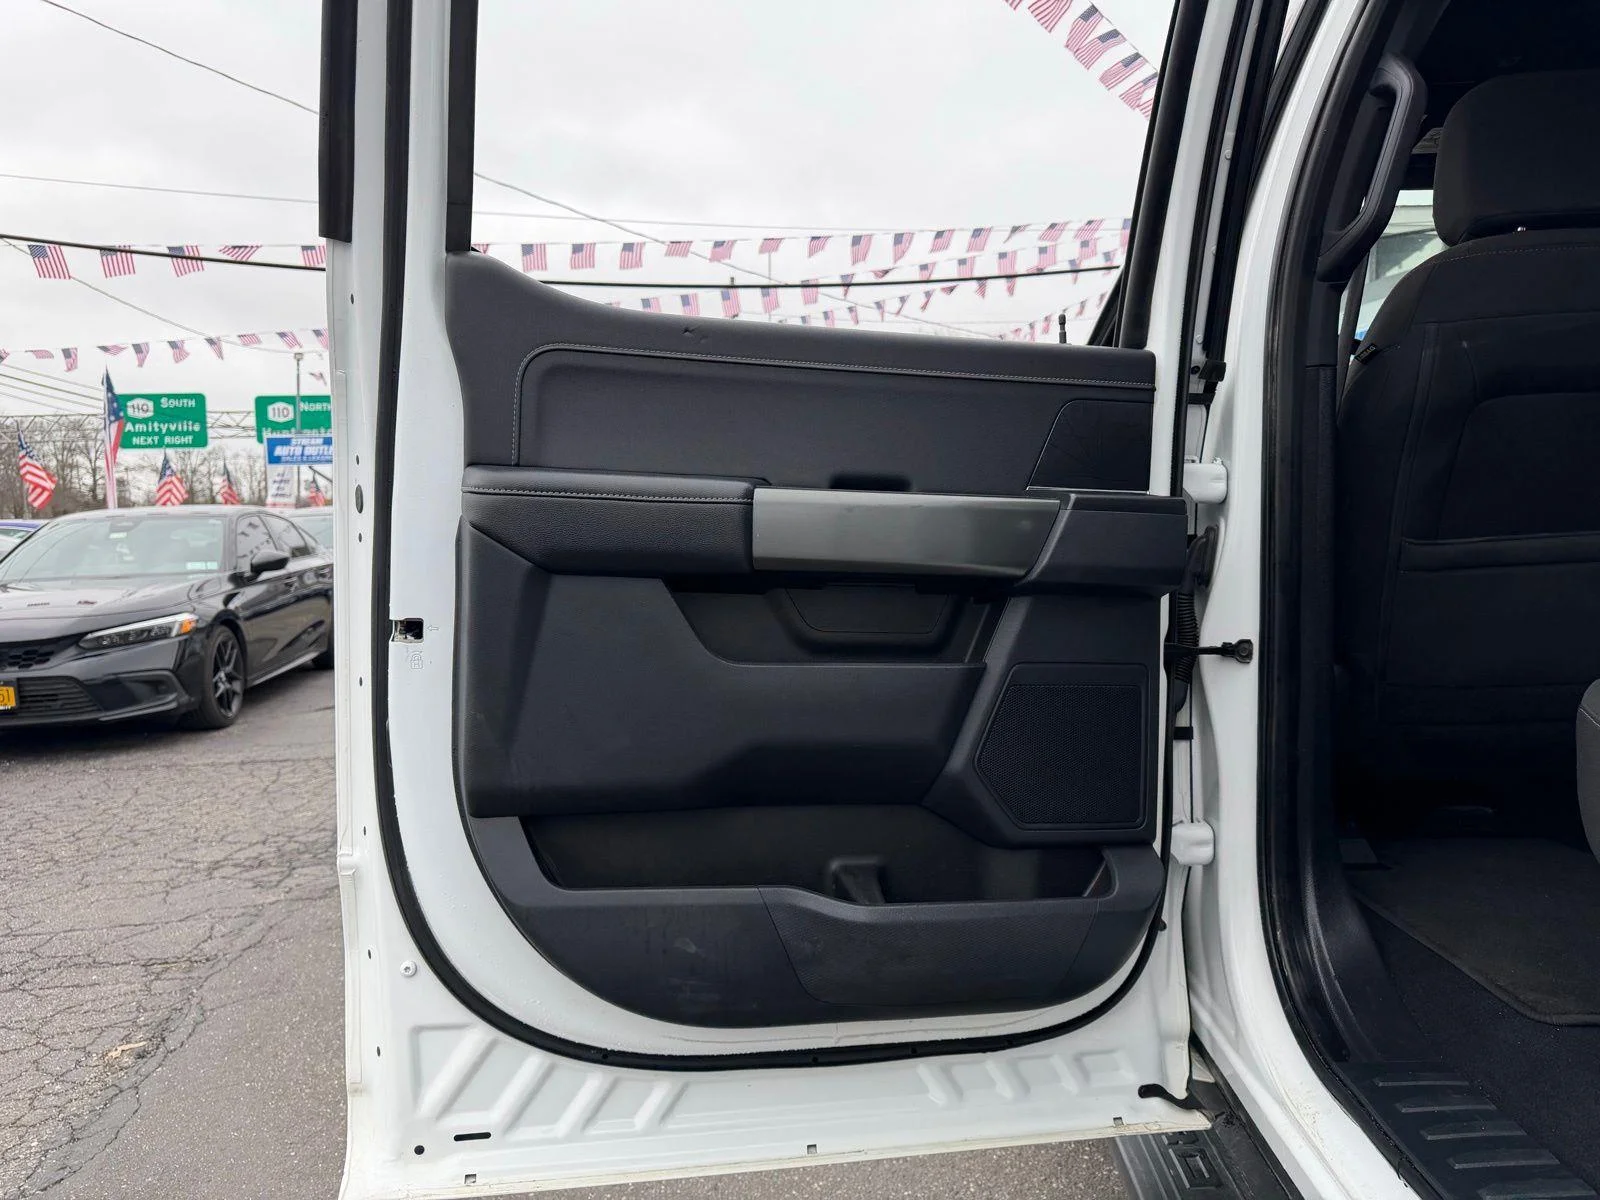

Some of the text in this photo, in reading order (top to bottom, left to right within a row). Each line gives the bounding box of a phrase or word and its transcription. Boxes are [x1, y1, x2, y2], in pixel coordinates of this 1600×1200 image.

[160, 397, 196, 408] SOUTH
[131, 403, 150, 414] 110
[272, 407, 289, 418] 110
[124, 421, 201, 434] Amityville
[132, 435, 194, 445] NEXT RIGHT
